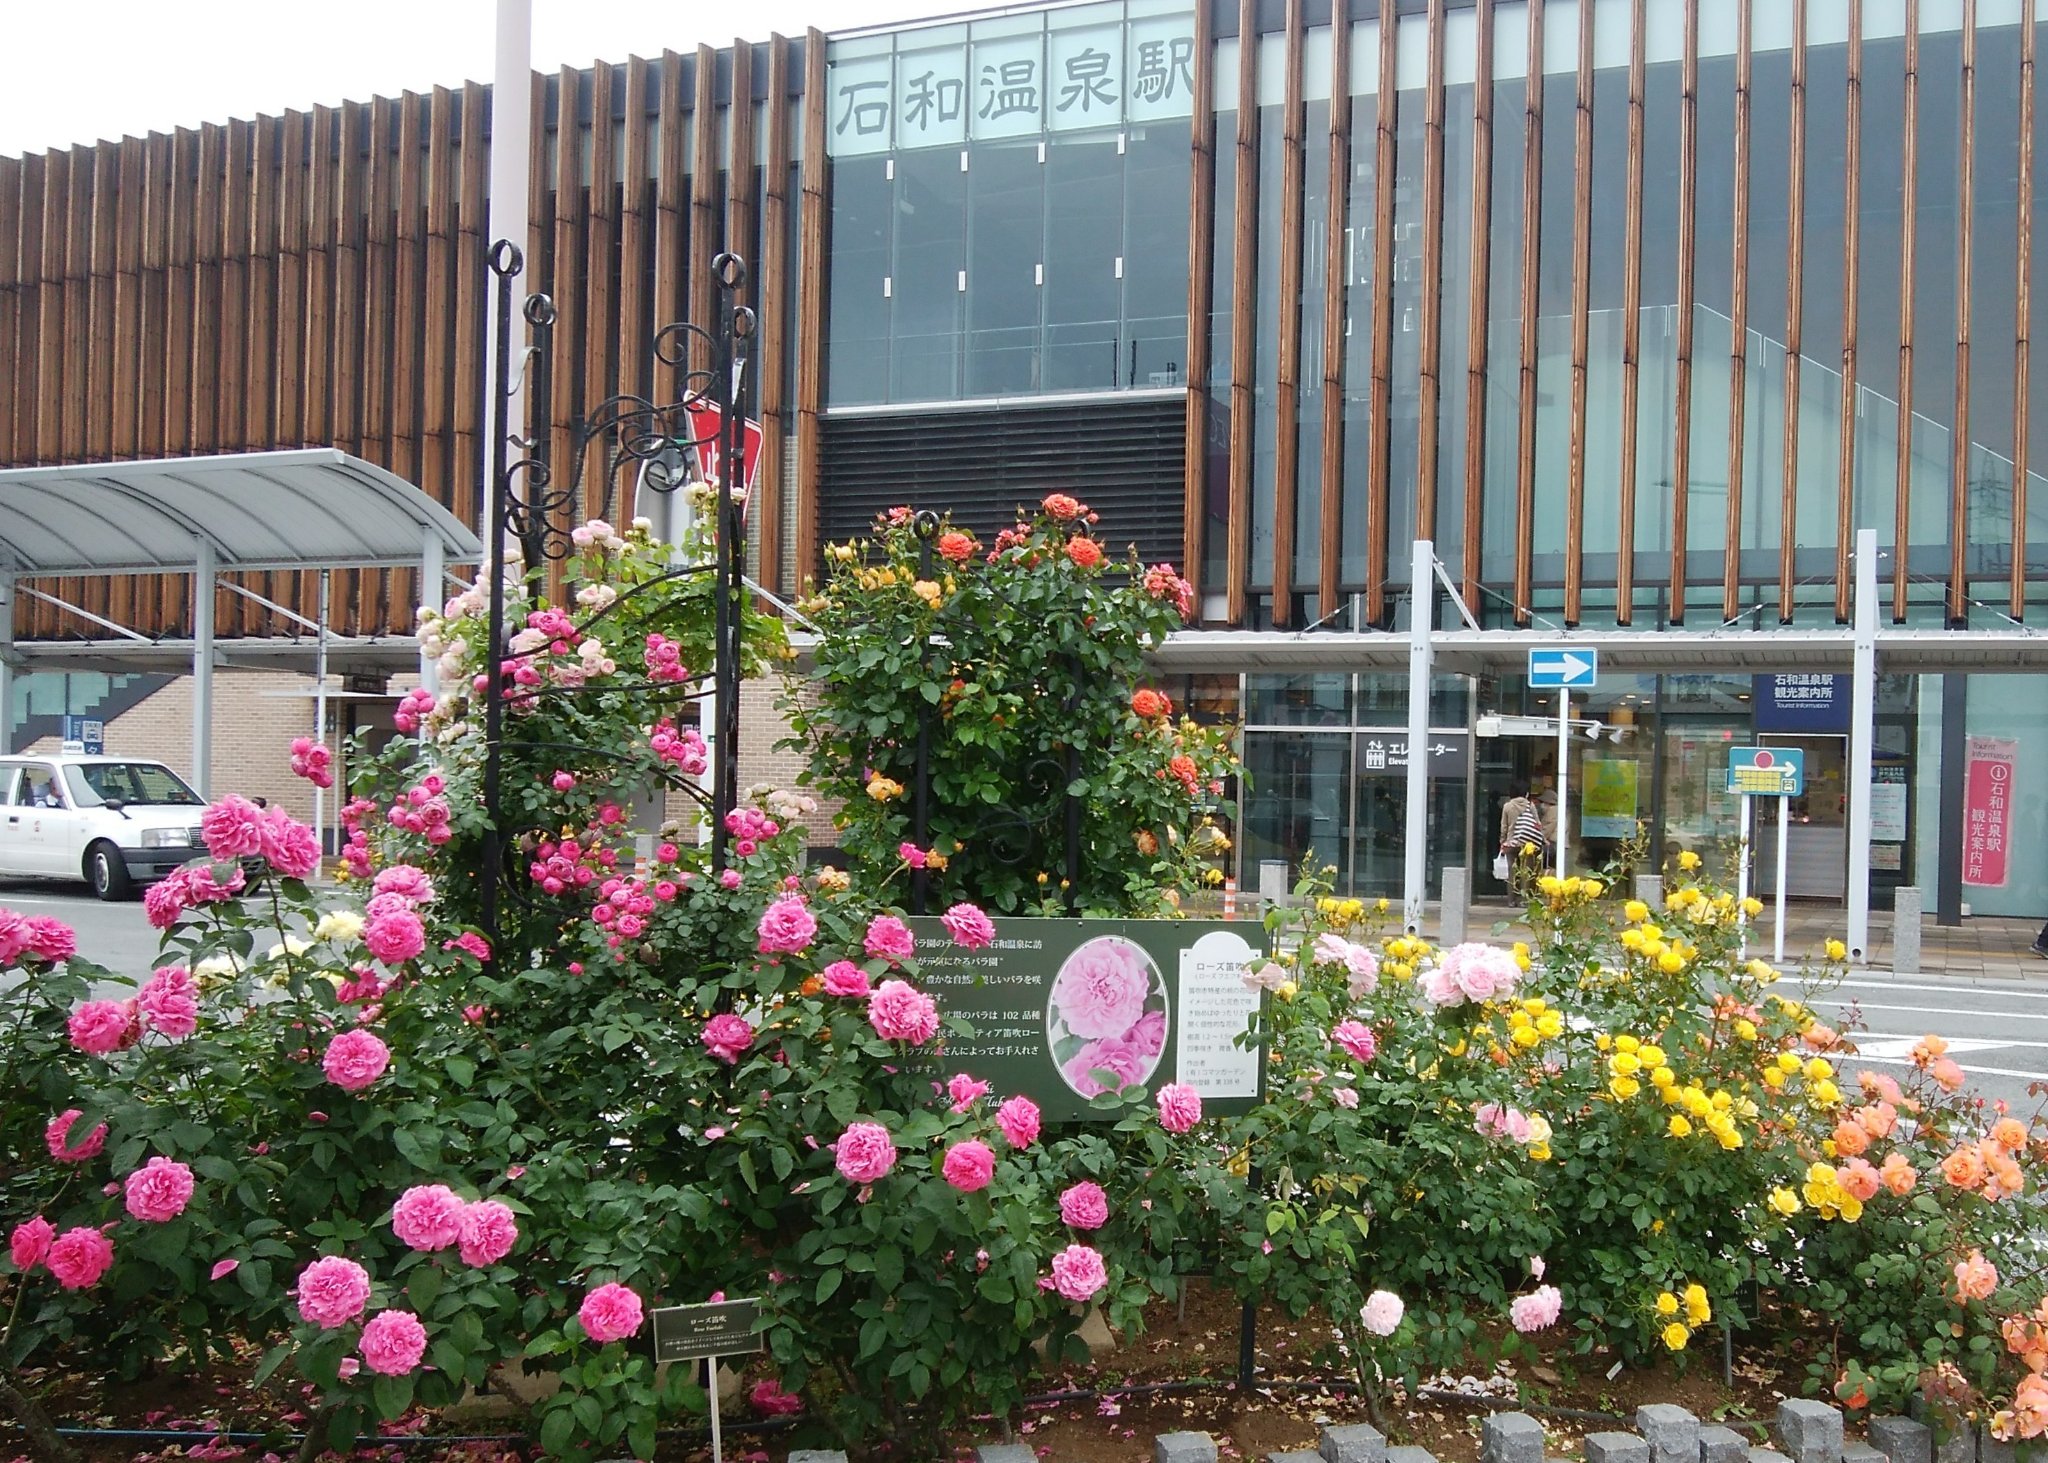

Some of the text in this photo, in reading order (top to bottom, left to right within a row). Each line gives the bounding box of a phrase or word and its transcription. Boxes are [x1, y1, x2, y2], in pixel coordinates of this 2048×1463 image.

[836, 37, 1193, 135] 石和温泉駅
[1775, 674, 1834, 685] 石和温泉駅
[1775, 687, 1833, 698] 観光案内所
[1389, 743, 1457, 756] エレーター
[1972, 751, 2013, 759] Information
[1986, 781, 2005, 852] 石和温泉駅
[1968, 808, 1986, 879] 観光案内所
[1002, 1011, 1019, 1020] 102
[1022, 1010, 1041, 1020] 品種
